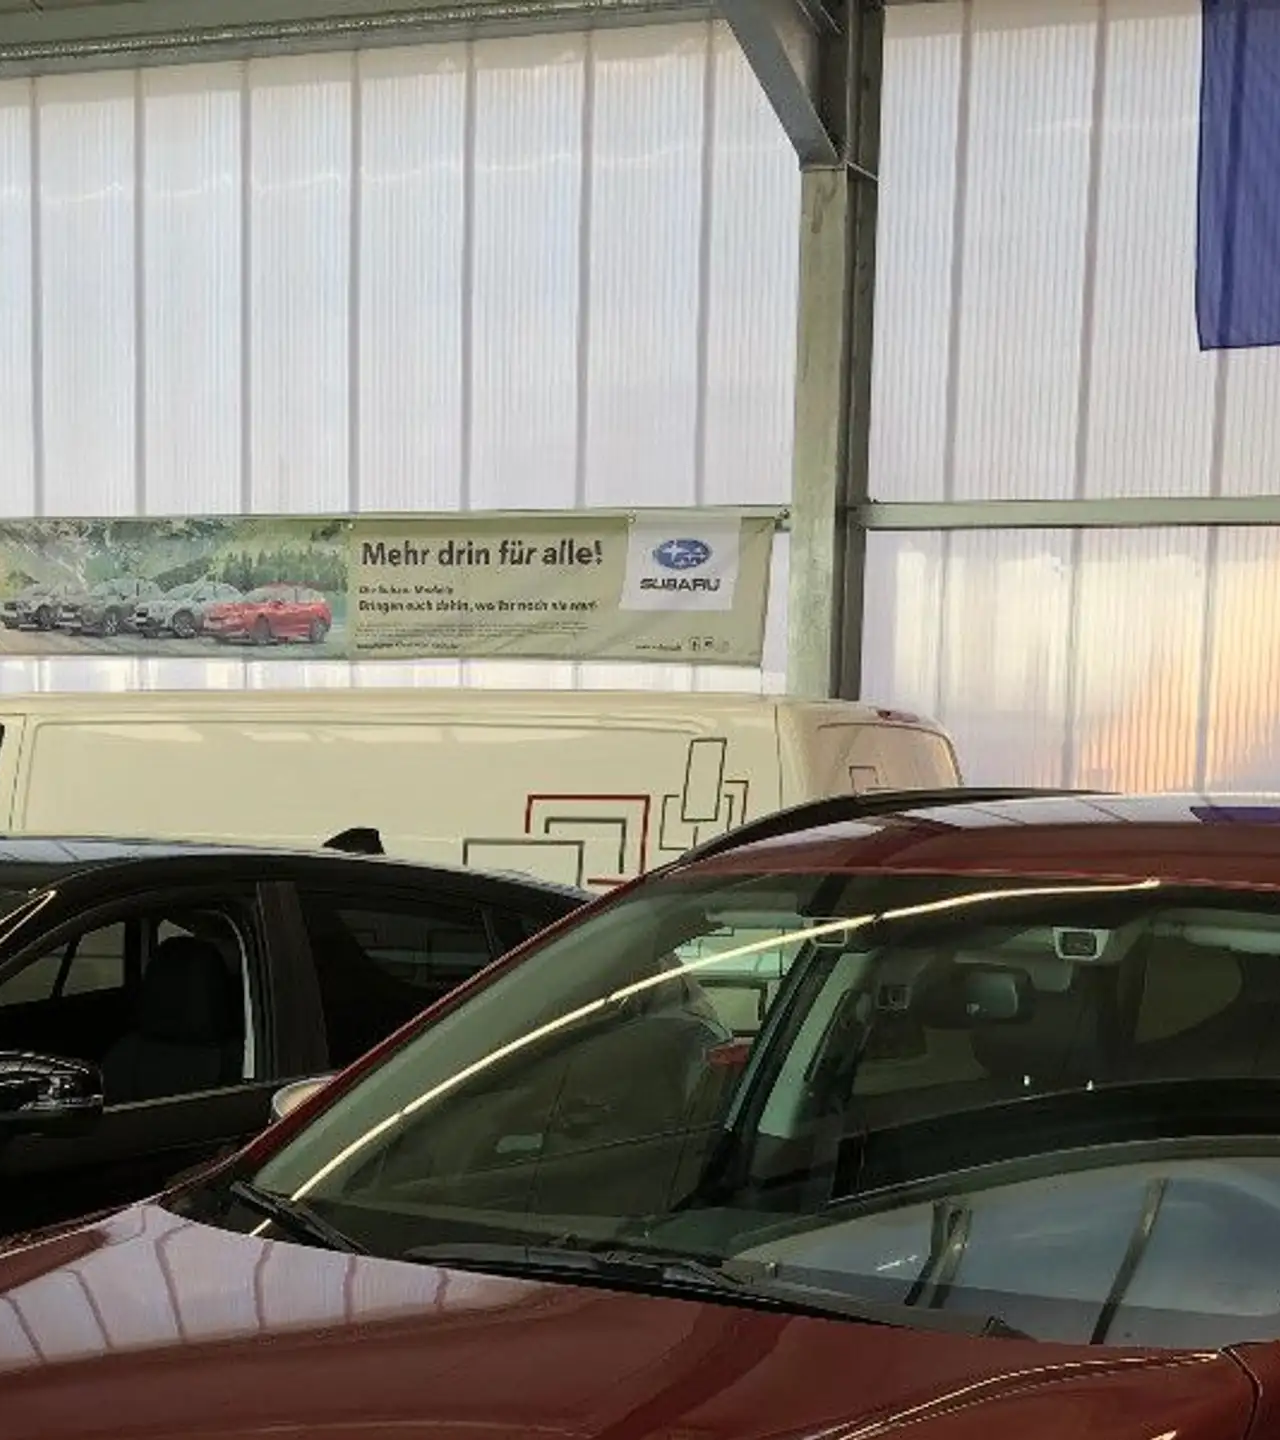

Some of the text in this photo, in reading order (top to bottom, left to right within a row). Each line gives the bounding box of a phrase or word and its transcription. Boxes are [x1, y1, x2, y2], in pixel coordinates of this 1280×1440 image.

[361, 538, 603, 567] Mehr drin für alle!
[640, 577, 721, 592] SUBARU
[475, 602, 496, 612] wo
